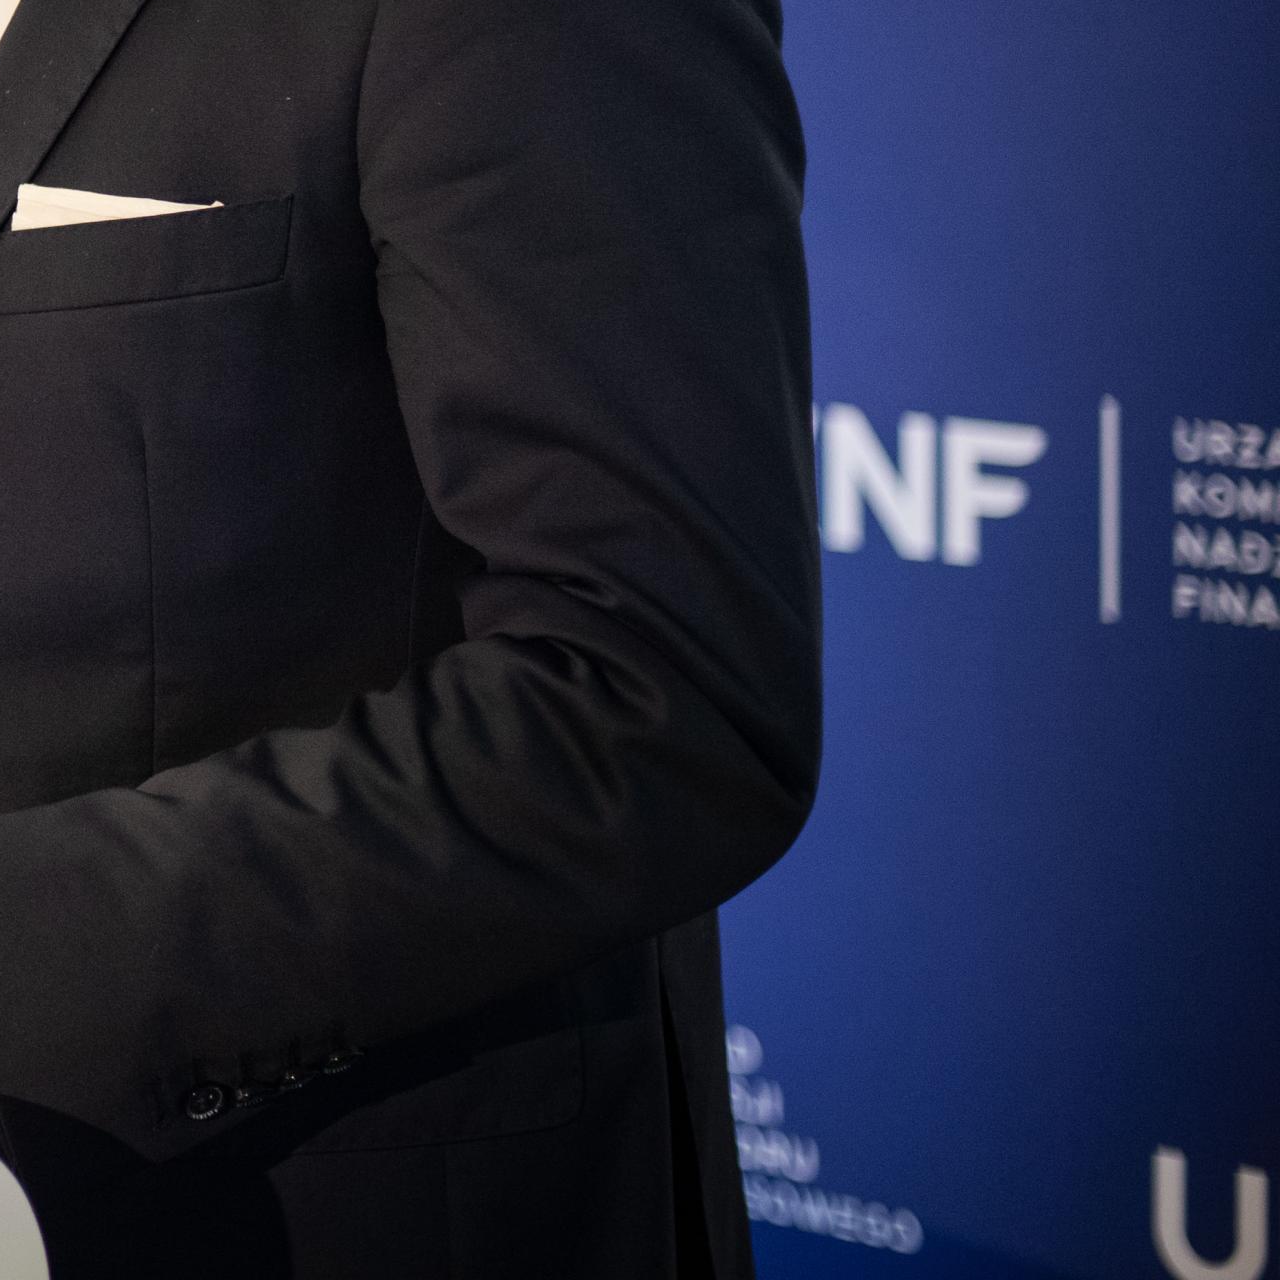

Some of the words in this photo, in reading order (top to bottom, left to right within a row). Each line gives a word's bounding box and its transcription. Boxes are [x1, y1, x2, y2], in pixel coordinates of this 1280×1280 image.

[813, 402, 1048, 567] NF
[1172, 469, 1280, 525] KOM
[1151, 1146, 1269, 1280] U
